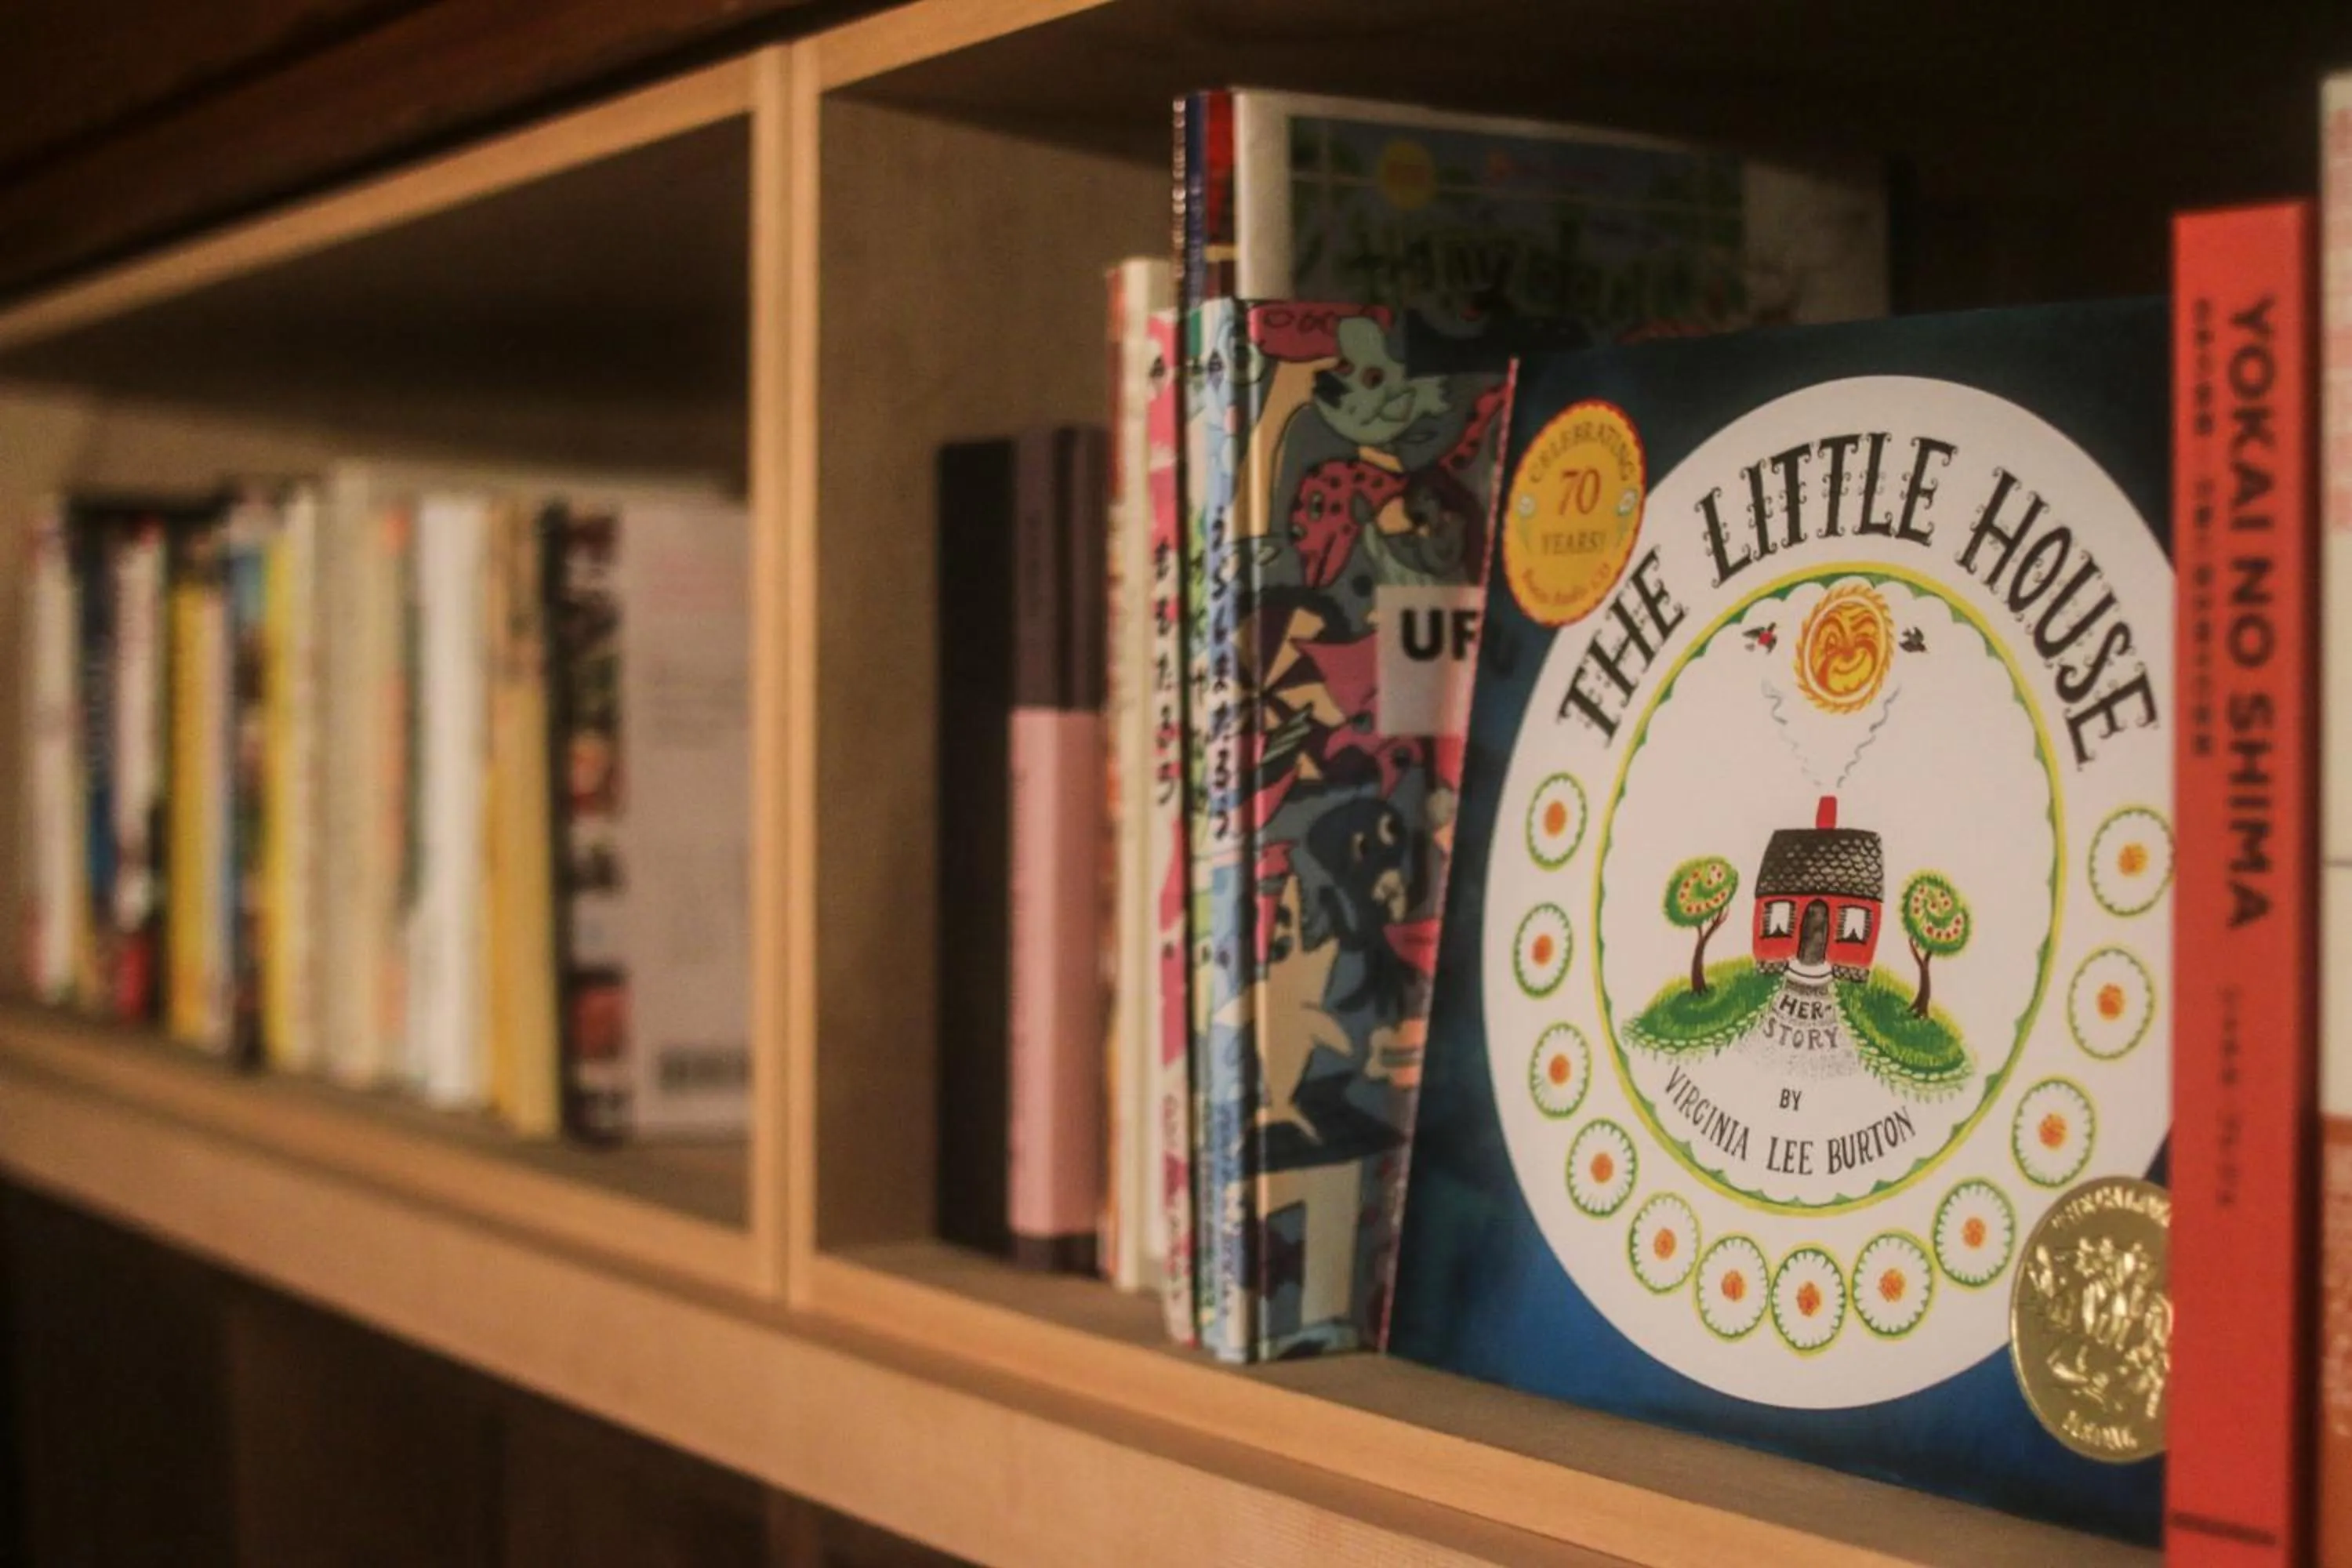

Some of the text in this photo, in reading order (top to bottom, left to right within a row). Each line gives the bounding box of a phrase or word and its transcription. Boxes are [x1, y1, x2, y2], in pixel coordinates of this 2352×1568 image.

[1530, 421, 1635, 483] CELEBRATING
[2228, 293, 2276, 532] YOKAI
[1558, 467, 1602, 515] 70
[1555, 544, 1688, 747] THE
[1694, 430, 1958, 589] LITTLE
[1955, 466, 2159, 771] HOUSE
[2228, 557, 2276, 667] NO
[2228, 691, 2274, 930] SHIMA
[1763, 1017, 1839, 1051] STORY
[1664, 1065, 1916, 1175] VIRGINIA LEE BURTON
[1779, 1087, 1802, 1111] BY
